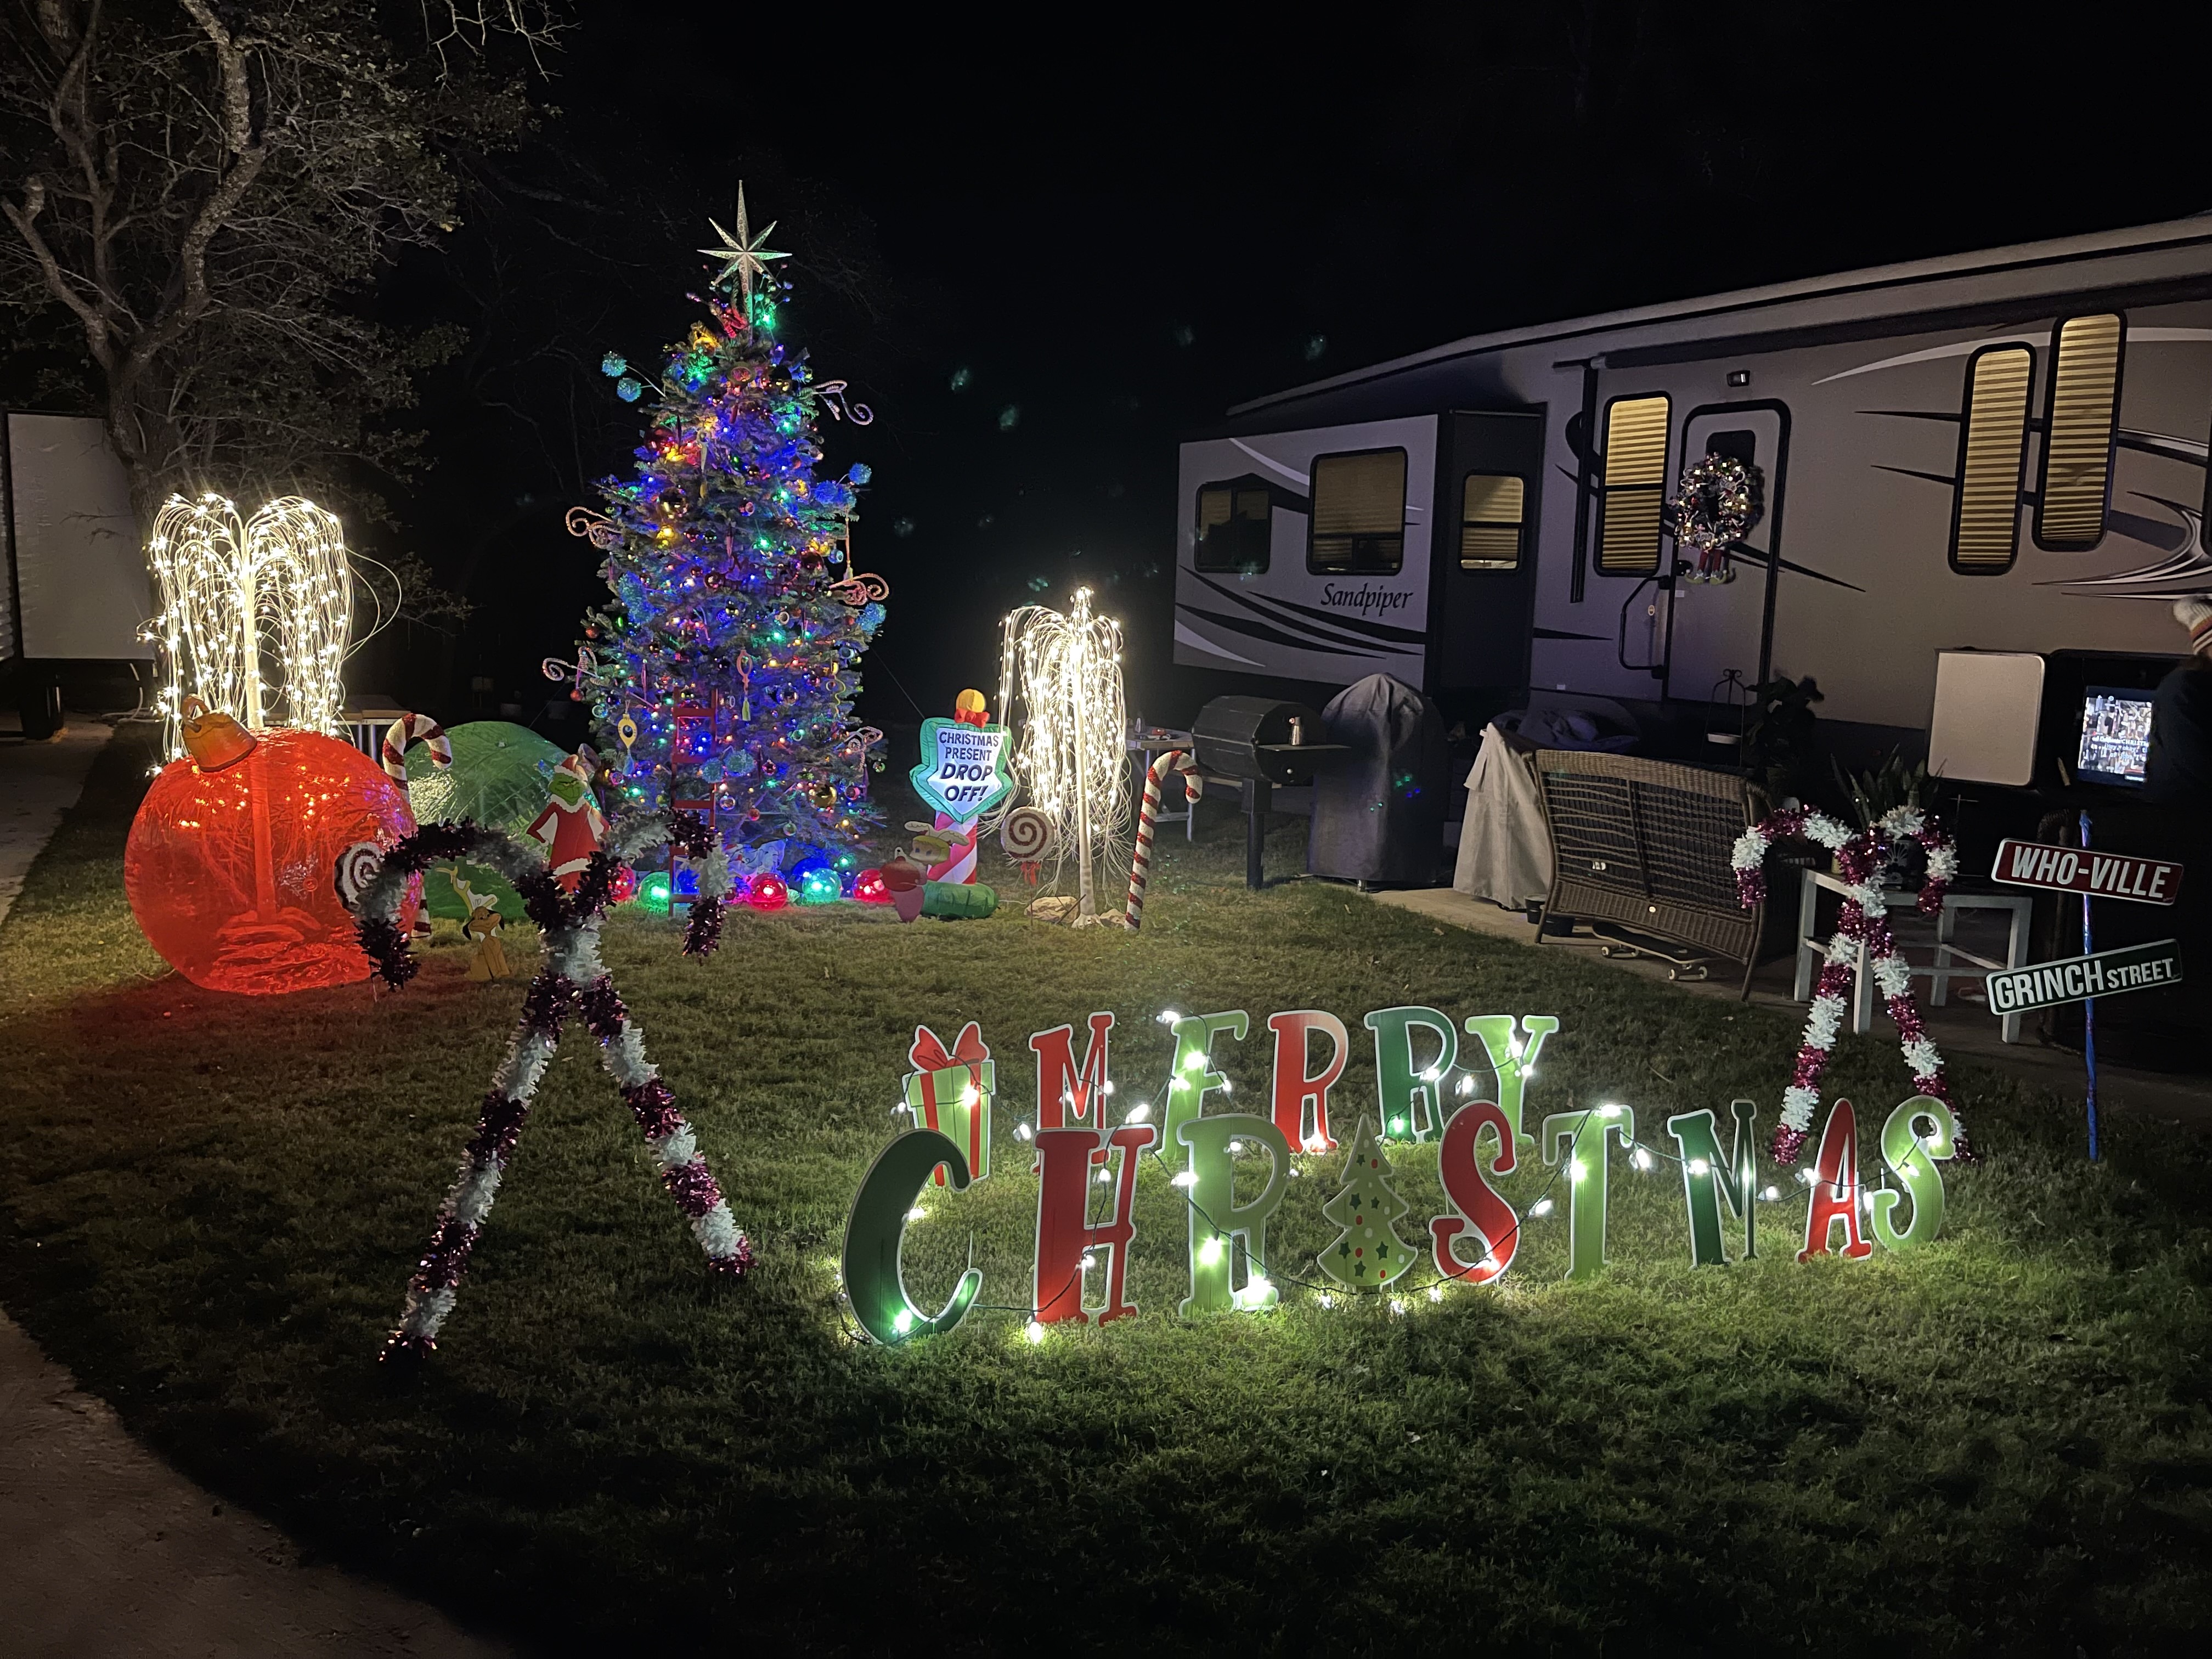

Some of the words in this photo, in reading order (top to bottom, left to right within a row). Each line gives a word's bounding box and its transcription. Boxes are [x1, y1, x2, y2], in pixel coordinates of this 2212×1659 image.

[1320, 582, 1414, 617] Sandpiper
[939, 731, 999, 747] CHRISTMAS
[944, 746, 992, 761] PRESENT
[939, 762, 993, 782] DROP
[944, 785, 989, 802] OFF!
[2011, 845, 2171, 899] WHO-VILLE
[1995, 959, 2104, 1009] GRINCH
[2106, 957, 2174, 989] STREET
[1029, 1006, 1559, 1173] MERRY
